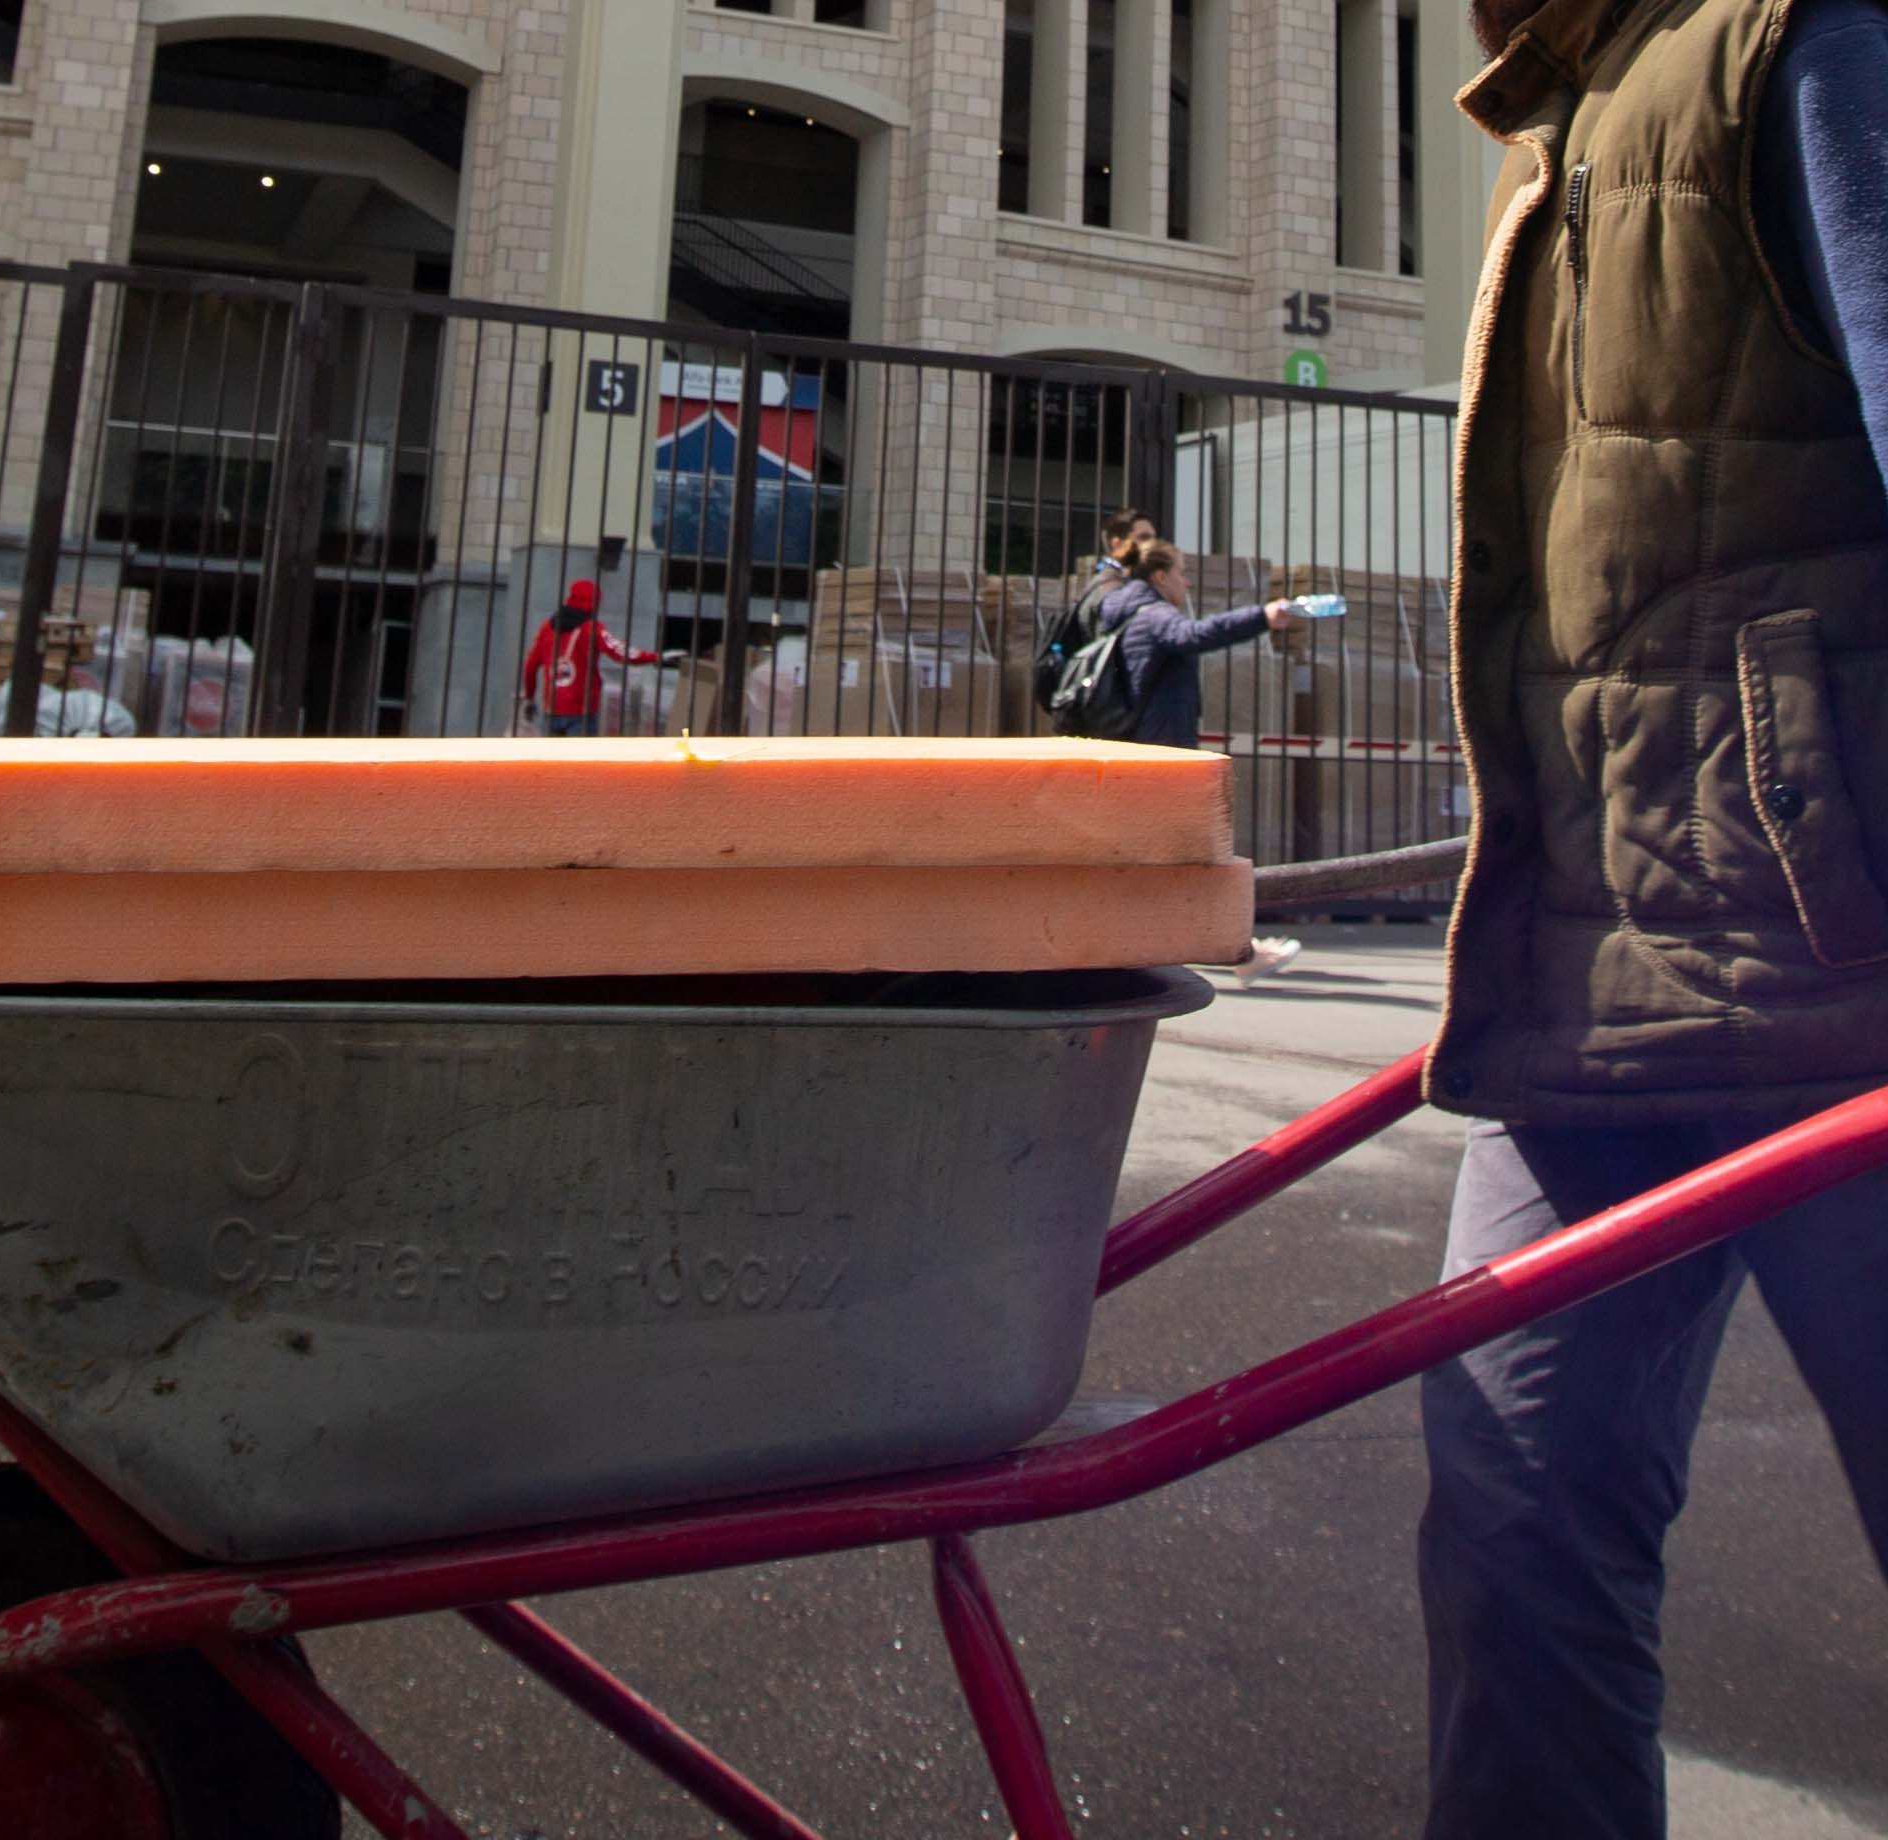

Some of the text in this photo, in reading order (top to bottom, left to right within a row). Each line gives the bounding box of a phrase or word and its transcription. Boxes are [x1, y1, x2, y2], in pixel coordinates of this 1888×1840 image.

[1282, 290, 1331, 337] 15
[597, 368, 625, 408] 5
[1296, 359, 1318, 388] B
